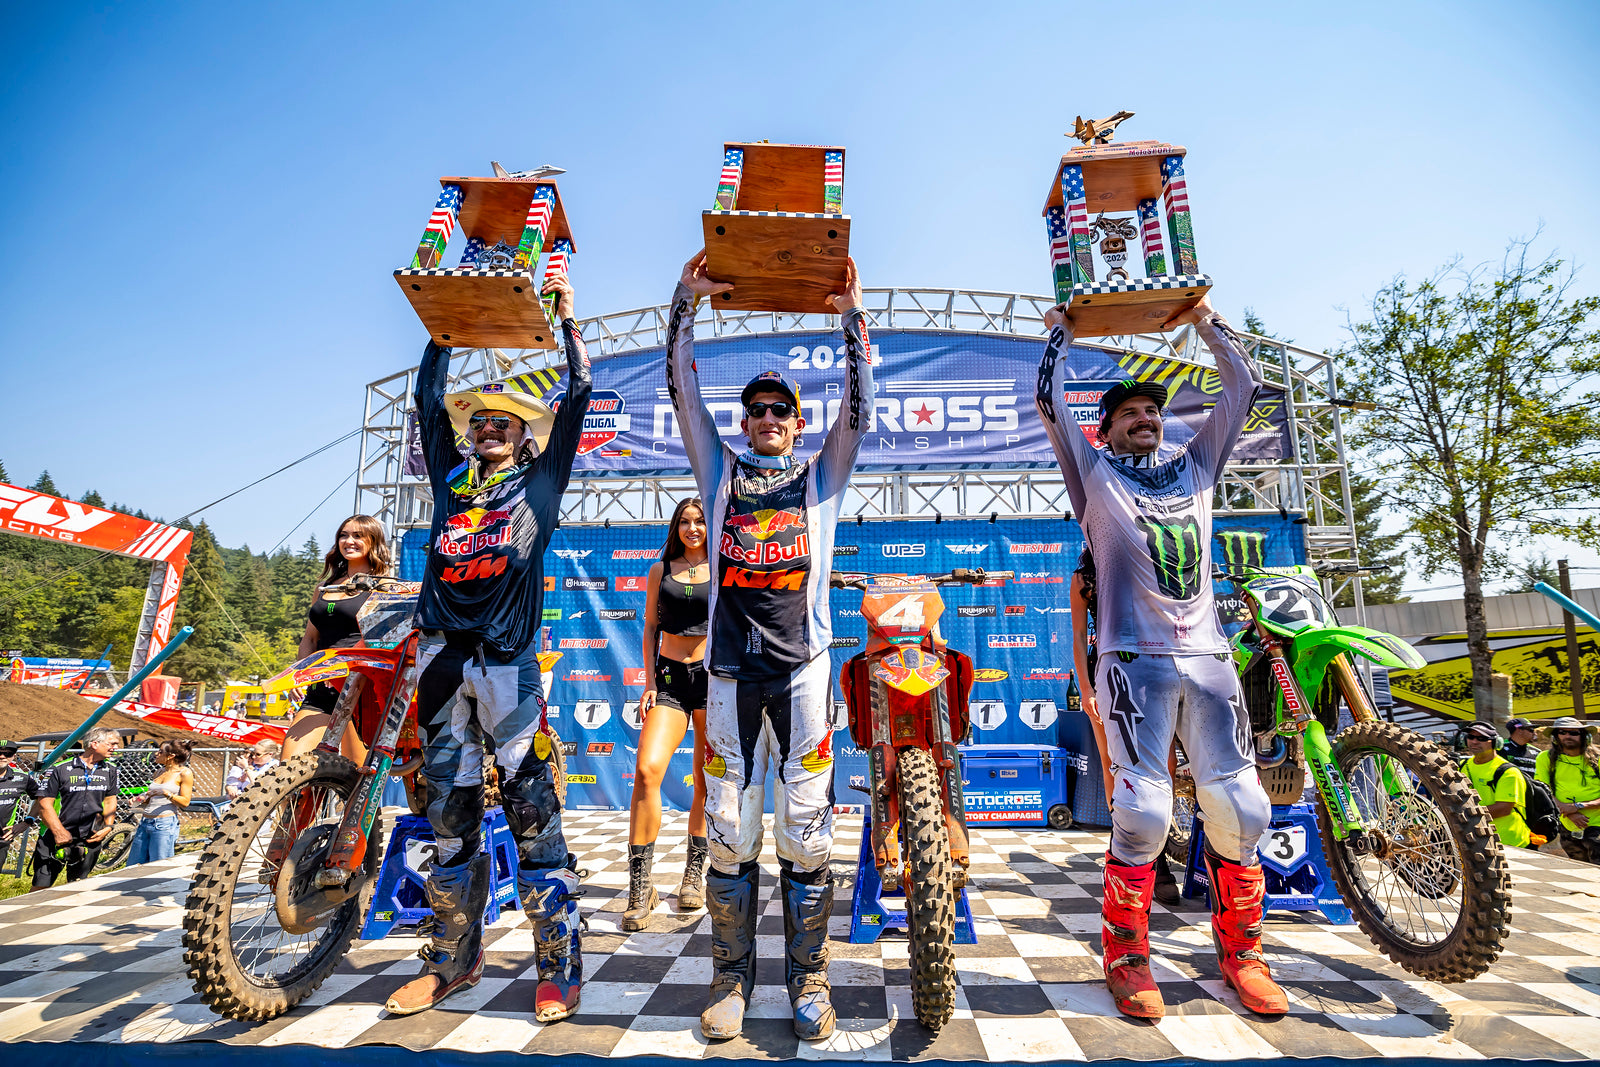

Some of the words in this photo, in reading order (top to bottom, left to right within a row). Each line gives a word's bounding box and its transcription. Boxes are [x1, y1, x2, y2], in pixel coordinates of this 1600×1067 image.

[1106, 253, 1127, 263] 2024
[652, 396, 1019, 438] OOROSS
[439, 532, 475, 556] Red
[475, 525, 514, 553] Bull
[720, 531, 763, 565] Red
[763, 532, 810, 565] Bull
[883, 545, 925, 557] WPS
[440, 553, 509, 584] KTM
[721, 566, 806, 591] KTM
[600, 610, 629, 618] TRIUMPH
[877, 593, 925, 632] 4
[958, 606, 988, 614] TRIUMPH
[1264, 585, 1324, 624] 21
[988, 634, 1036, 643] PARTS
[1271, 662, 1301, 710] SHOWA
[182, 711, 263, 737] FLY
[587, 743, 614, 753] ETS
[841, 746, 868, 755] NAM
[566, 774, 595, 783] CERBIS
[874, 761, 888, 822] DUOP
[946, 749, 961, 809] DUNLP
[964, 795, 1042, 806] OTOCROSS
[990, 811, 1042, 820] CHAMPAGNE
[419, 843, 438, 872] 2
[1271, 831, 1294, 861] 3
